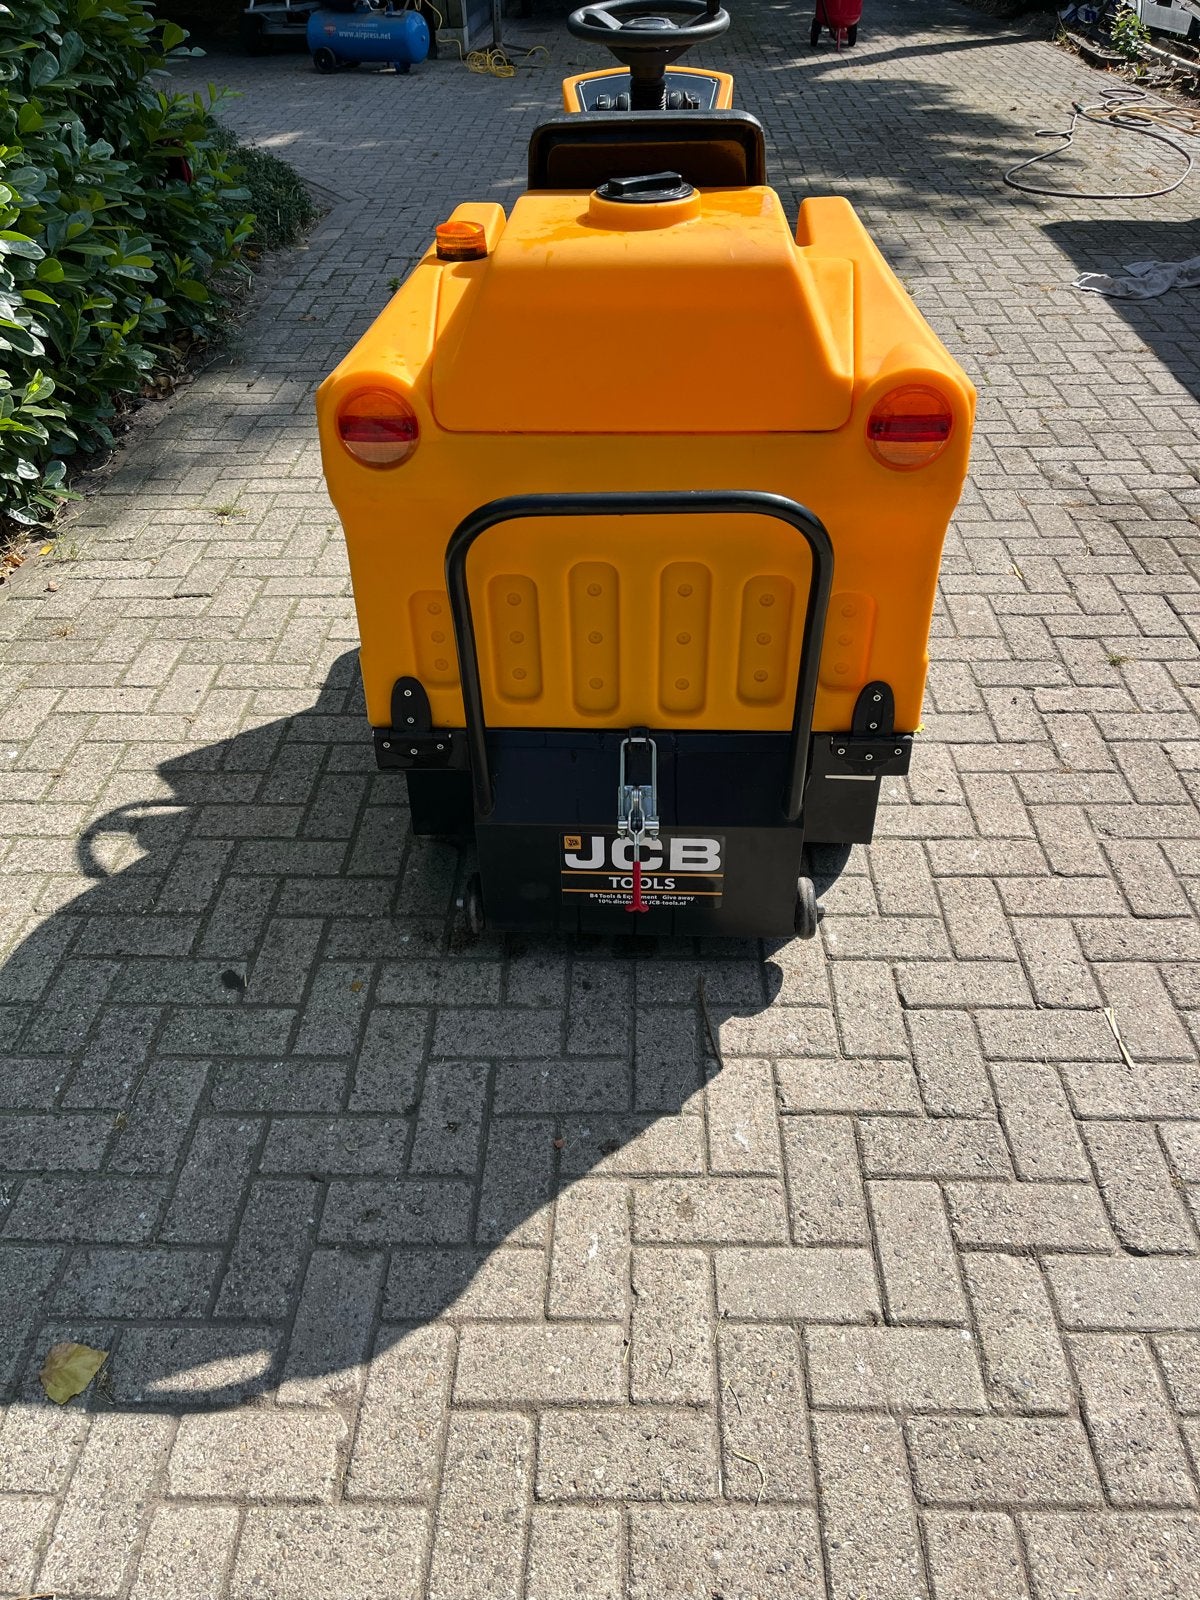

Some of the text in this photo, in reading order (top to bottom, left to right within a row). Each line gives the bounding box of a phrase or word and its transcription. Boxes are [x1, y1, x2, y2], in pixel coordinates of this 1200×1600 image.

[338, 31, 391, 40] www.airpress.net
[564, 836, 722, 871] JCB
[608, 876, 676, 890] TOOLS
